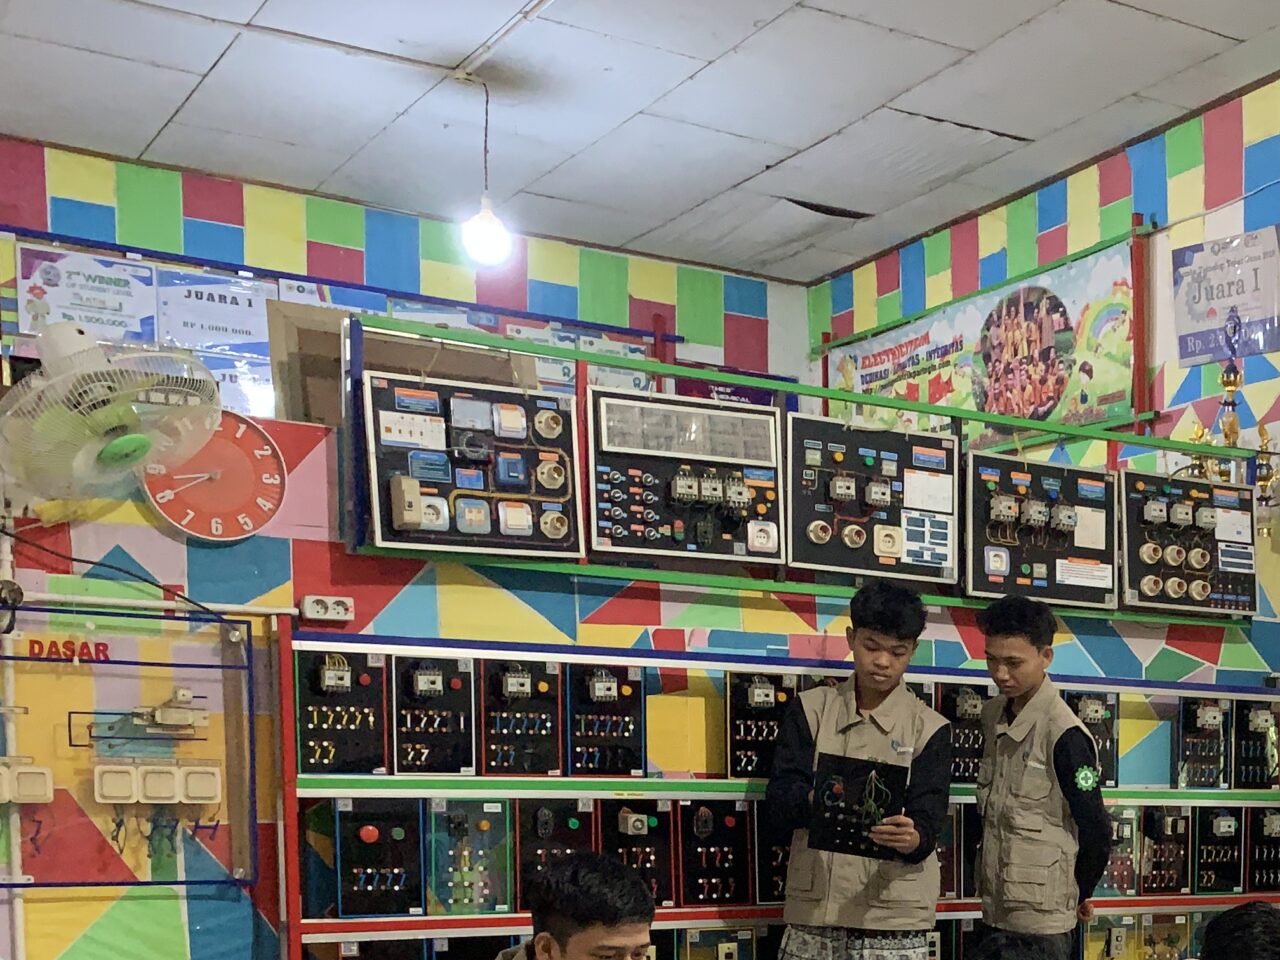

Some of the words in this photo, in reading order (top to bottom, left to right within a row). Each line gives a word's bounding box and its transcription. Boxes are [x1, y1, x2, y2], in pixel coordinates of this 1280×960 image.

[184, 289, 240, 306] JUARA
[1192, 277, 1245, 304] Juara
[235, 423, 247, 438] 1
[254, 445, 272, 459] 2
[262, 473, 281, 484] 3
[155, 489, 175, 504] 8
[256, 496, 275, 511] 4
[181, 509, 195, 526] 7
[211, 517, 223, 535] 6
[237, 513, 253, 531] 5
[28, 639, 110, 661] DASAR
